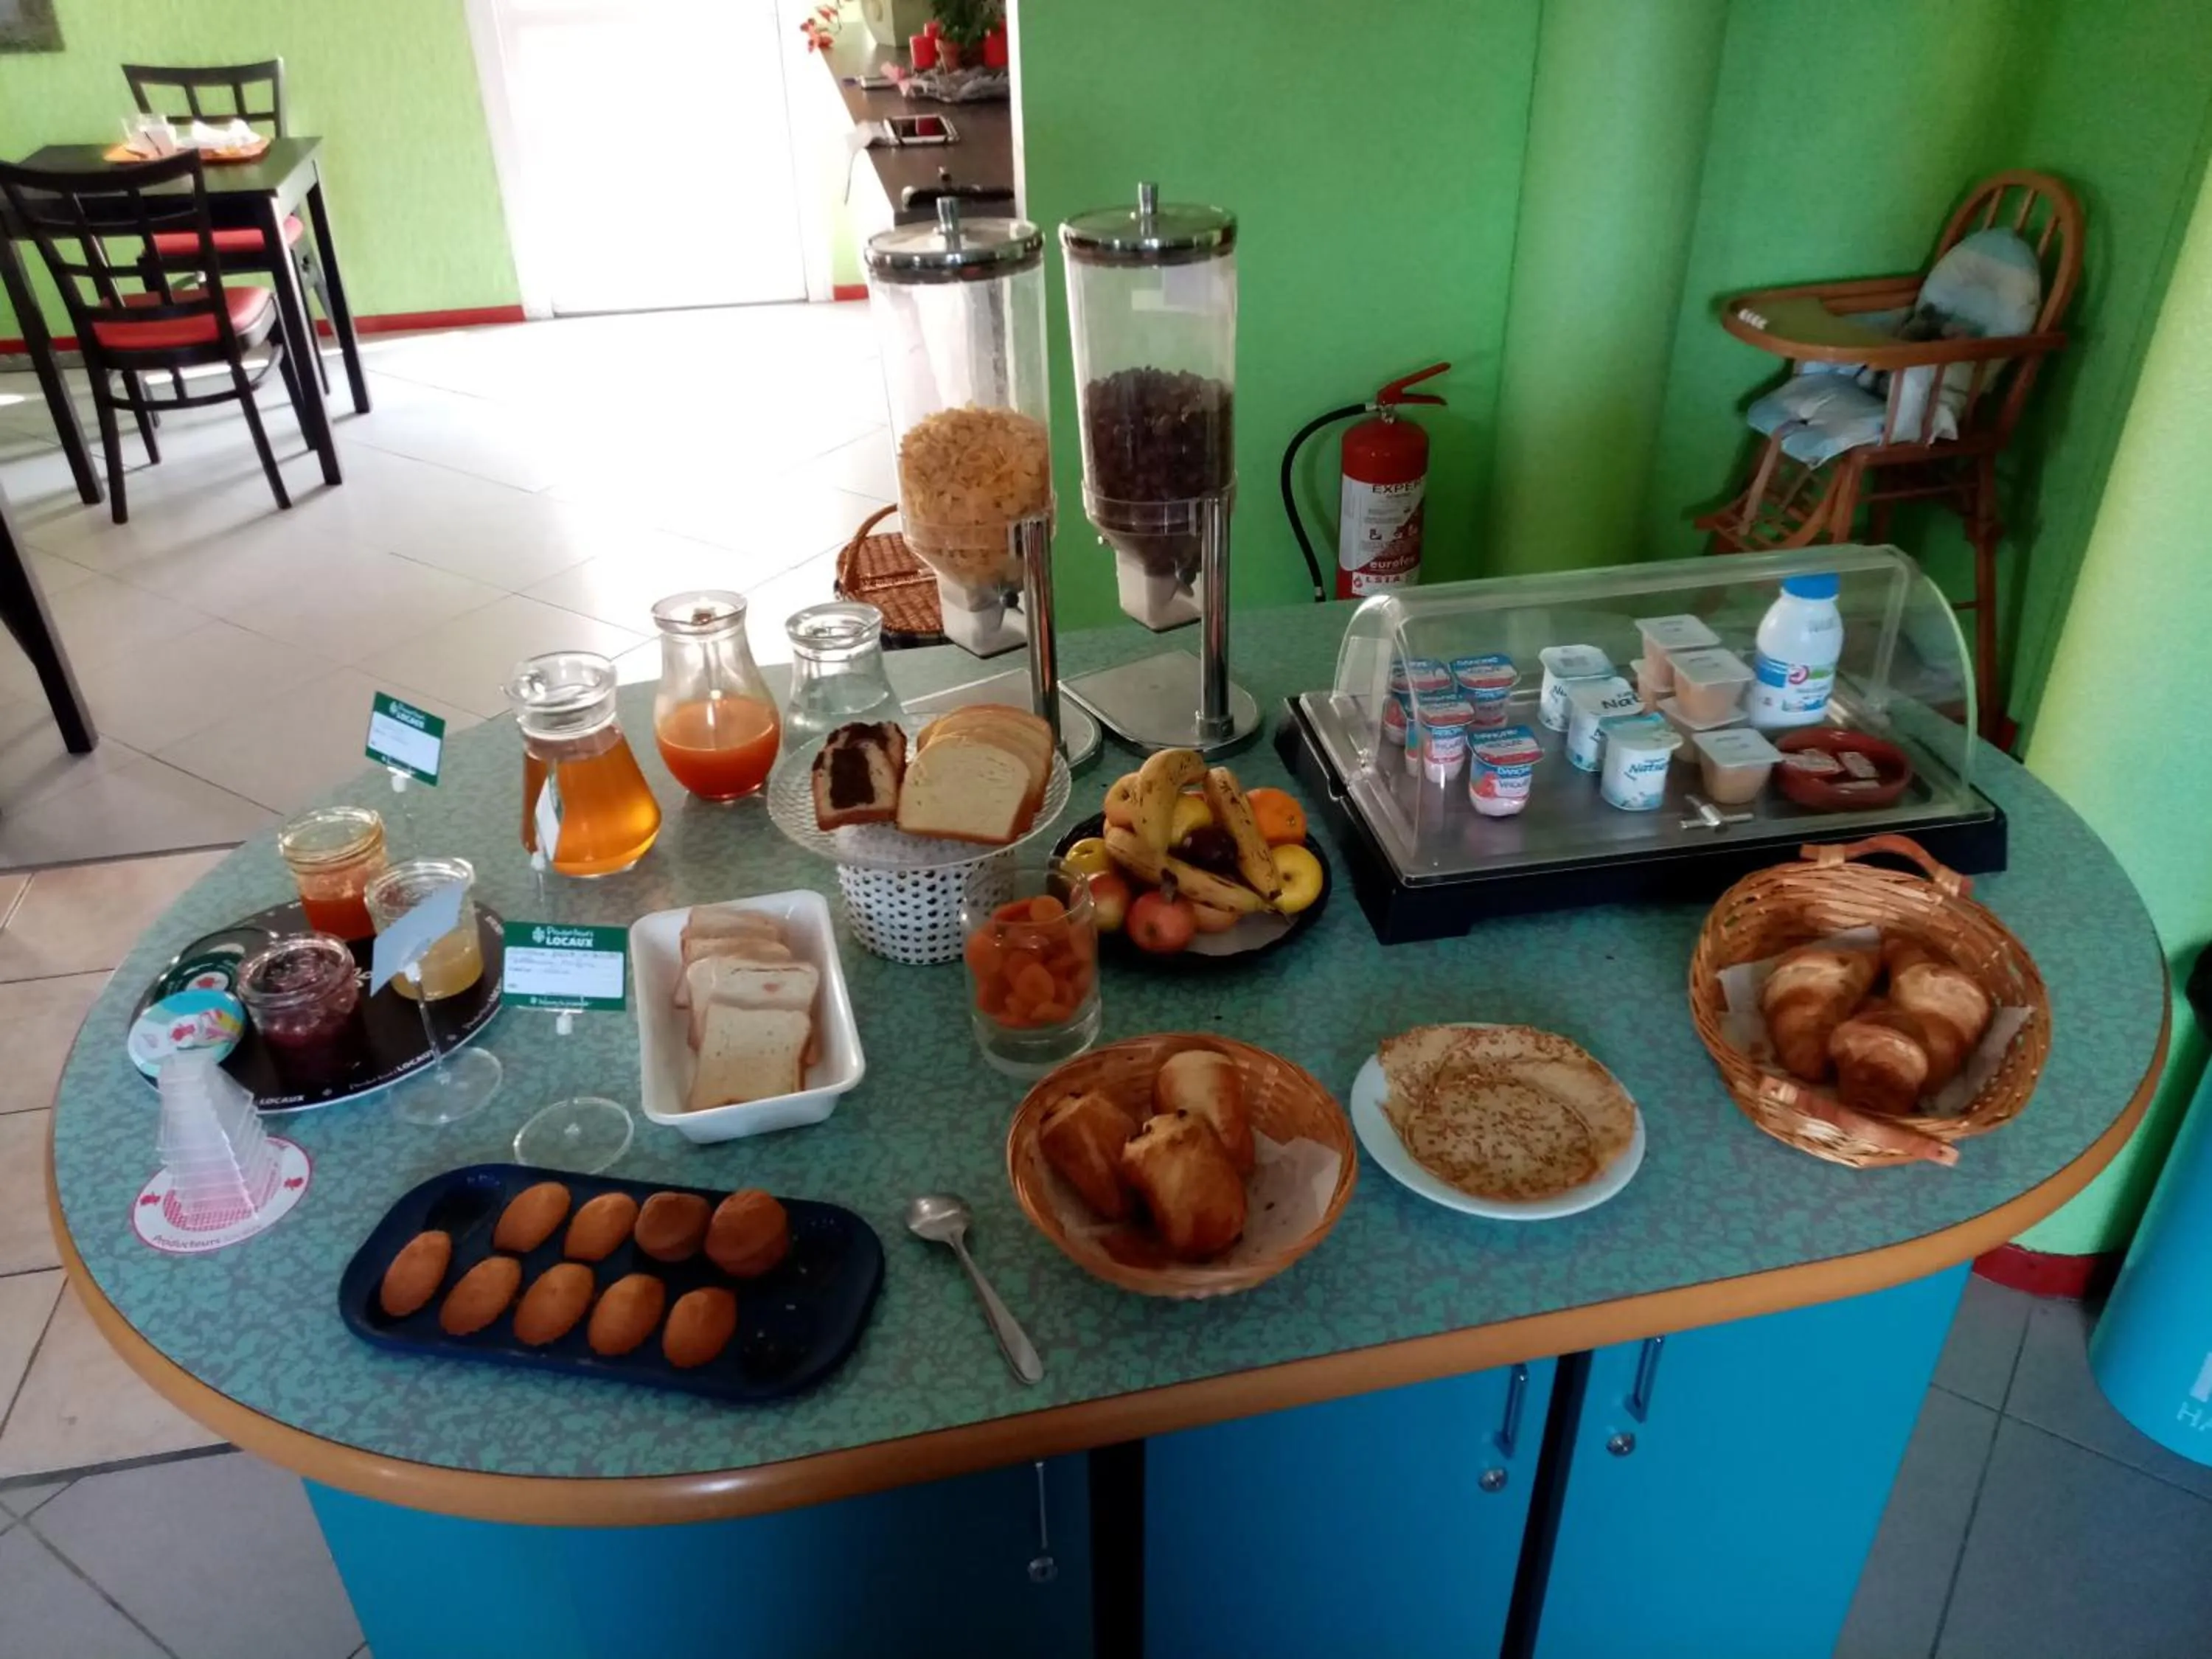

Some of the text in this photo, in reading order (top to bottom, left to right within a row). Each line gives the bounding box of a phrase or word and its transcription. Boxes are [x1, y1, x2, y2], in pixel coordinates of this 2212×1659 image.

[546, 936, 594, 947] LOCAUX
[396, 1048, 434, 1072] LOCAU
[258, 1094, 305, 1106] LOCAUX
